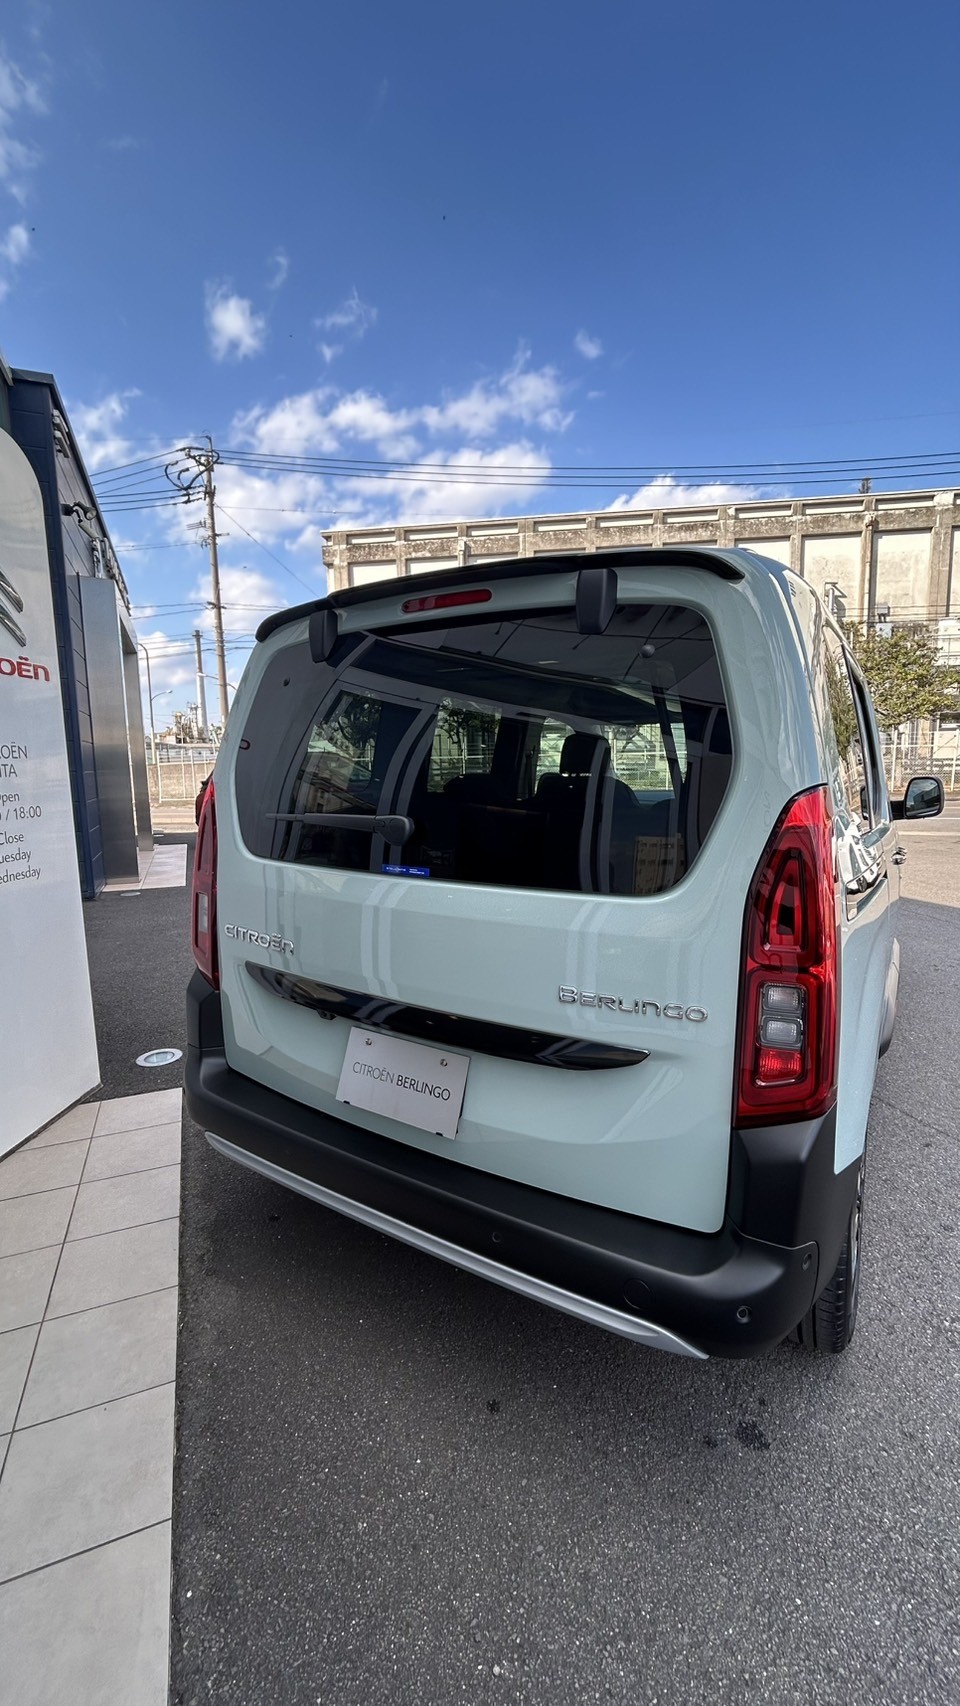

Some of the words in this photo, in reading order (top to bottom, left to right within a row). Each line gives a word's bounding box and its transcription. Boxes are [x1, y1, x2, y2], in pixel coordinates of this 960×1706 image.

[0, 741, 28, 760] OËN
[0, 793, 20, 807] pen
[13, 805, 42, 820] 18:00
[558, 984, 709, 1023] BERLINGO
[352, 1061, 395, 1084] CITROËN
[396, 1074, 451, 1101] BERLINGO
